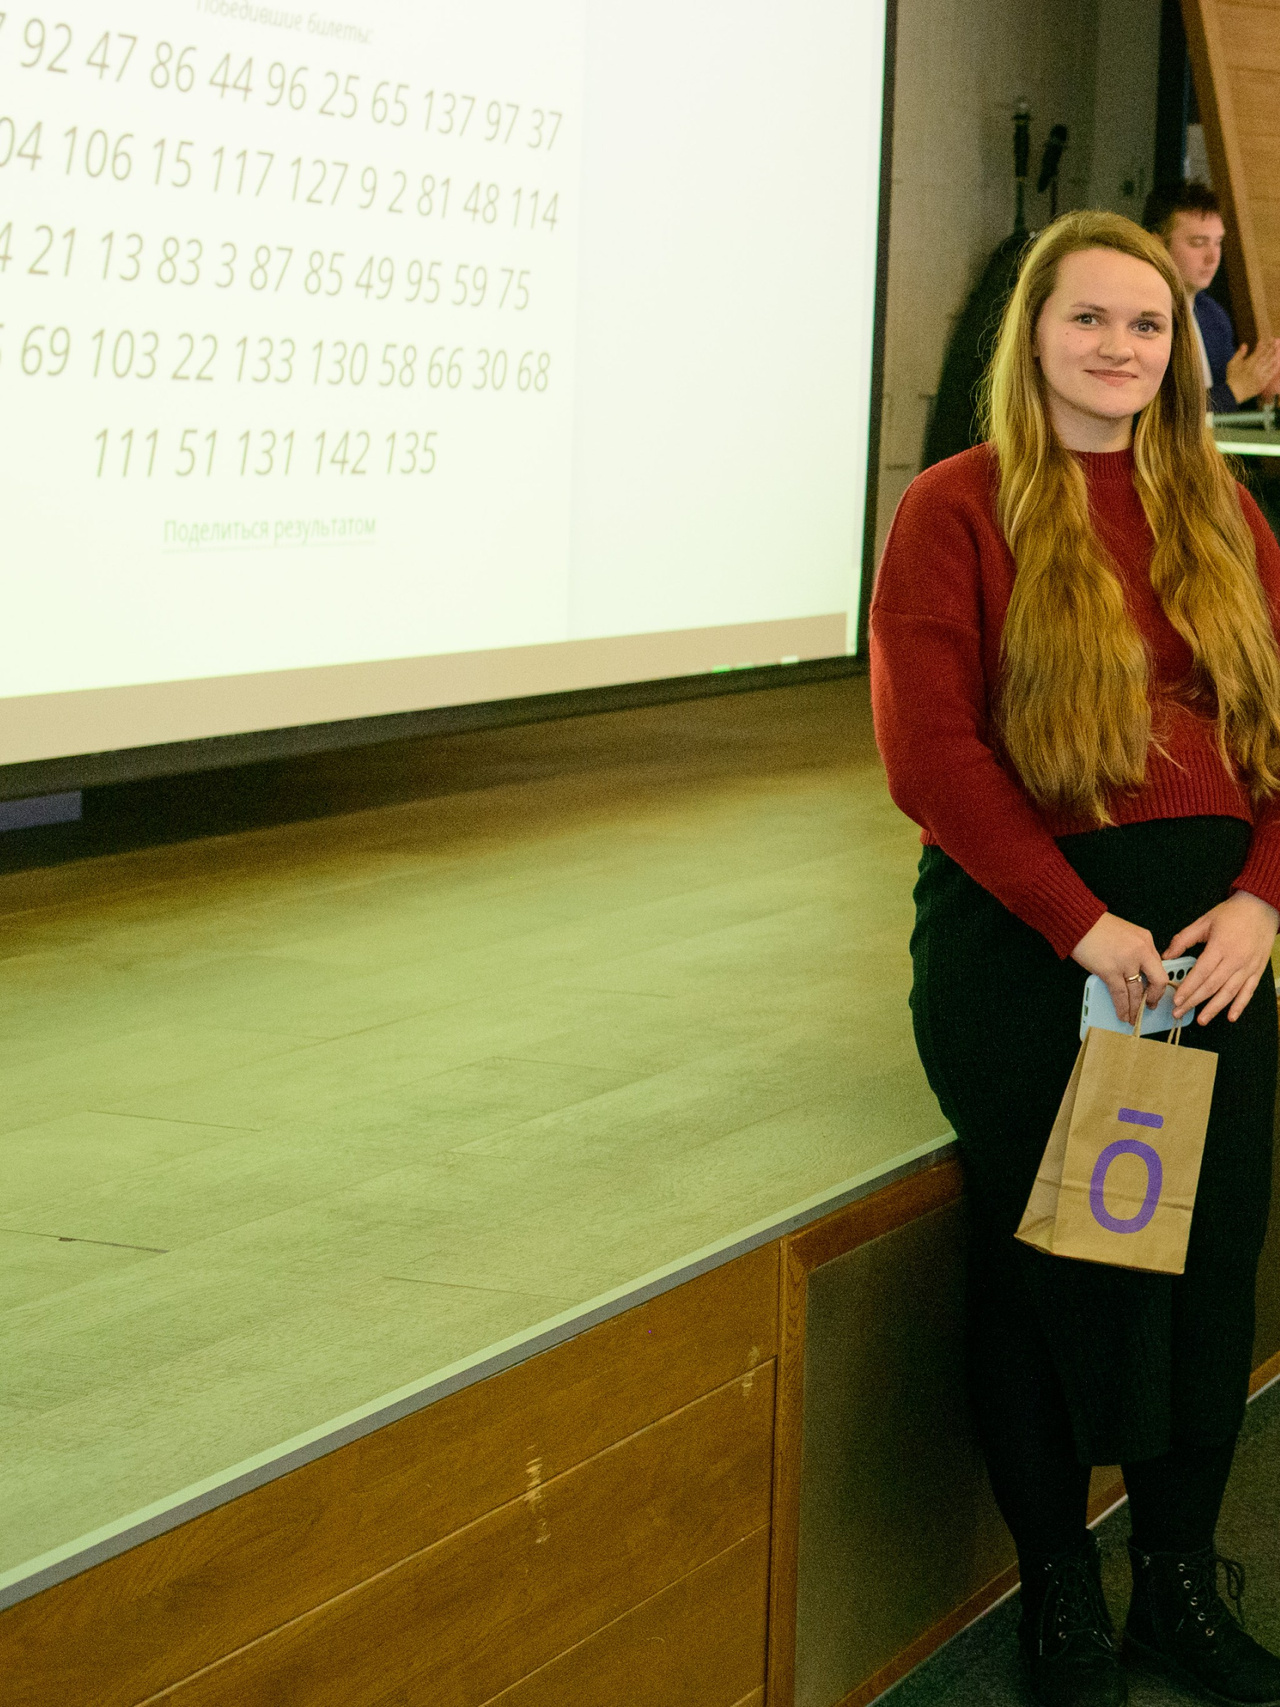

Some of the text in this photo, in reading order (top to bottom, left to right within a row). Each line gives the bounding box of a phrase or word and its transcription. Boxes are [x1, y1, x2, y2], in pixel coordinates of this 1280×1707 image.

[20, 17, 73, 75] 92
[85, 30, 138, 83] 47
[149, 40, 197, 93] 86
[208, 52, 254, 103] 44
[265, 61, 309, 111] 96
[317, 70, 361, 119] 25
[370, 80, 411, 127] 65
[423, 89, 476, 137] 137
[484, 100, 520, 145] 97
[527, 108, 563, 151] 37
[63, 125, 134, 182] 106
[152, 137, 195, 188] 15
[211, 145, 275, 197] 117
[289, 156, 349, 205] 127
[358, 165, 378, 210] 9
[387, 169, 407, 214] 2
[416, 173, 451, 219] 81
[462, 181, 500, 225] 48
[511, 187, 559, 232] 114
[26, 223, 77, 277] 21
[100, 230, 144, 282] 13
[156, 235, 204, 286] 83
[214, 241, 238, 289] 3
[248, 244, 294, 292] 87
[303, 249, 346, 297] 85
[354, 254, 395, 301] 49
[404, 259, 442, 304] 95
[451, 263, 488, 308] 59
[498, 267, 531, 312] 75
[20, 324, 71, 377] 69
[90, 327, 160, 380] 103
[170, 332, 219, 382] 22
[235, 335, 296, 384] 133
[311, 339, 369, 387] 130
[377, 342, 418, 388] 58
[426, 345, 464, 390] 66
[471, 347, 508, 392] 30
[516, 350, 551, 394] 68
[94, 427, 439, 479] 111 51 131 142 135
[162, 516, 378, 550] Поделиться результатом
